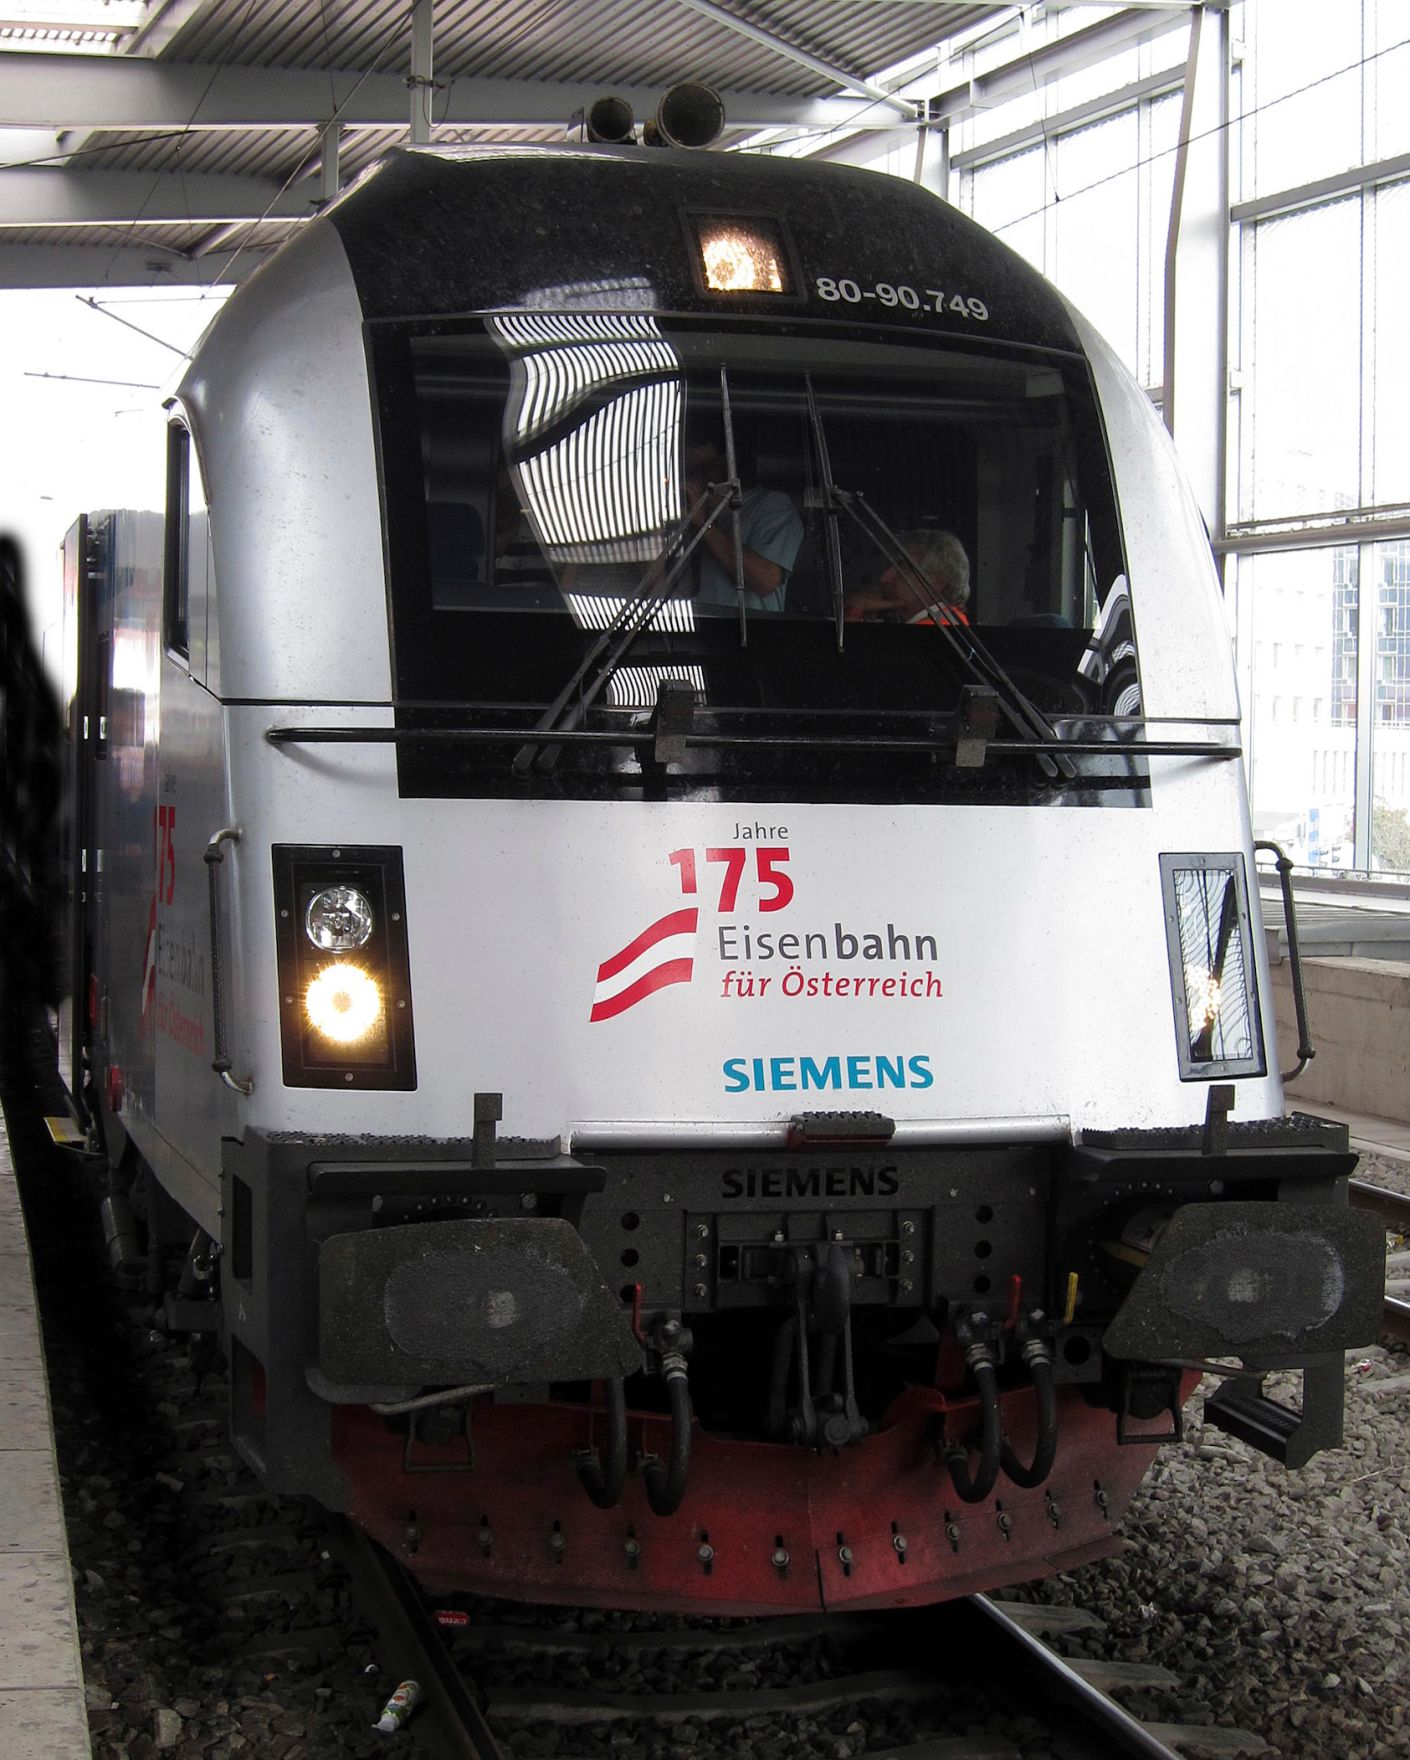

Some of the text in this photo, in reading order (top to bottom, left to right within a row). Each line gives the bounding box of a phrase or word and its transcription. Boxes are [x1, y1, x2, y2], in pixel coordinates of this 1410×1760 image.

[816, 277, 989, 320] 80-90.749
[733, 822, 789, 840] Jahre
[668, 847, 795, 913] 175
[158, 923, 204, 997] Eenbahn
[718, 923, 939, 961] Eisenbahn
[720, 966, 943, 998] für Österreich
[722, 1055, 934, 1093] SIEMENS
[722, 1166, 899, 1200] SIEMENS
